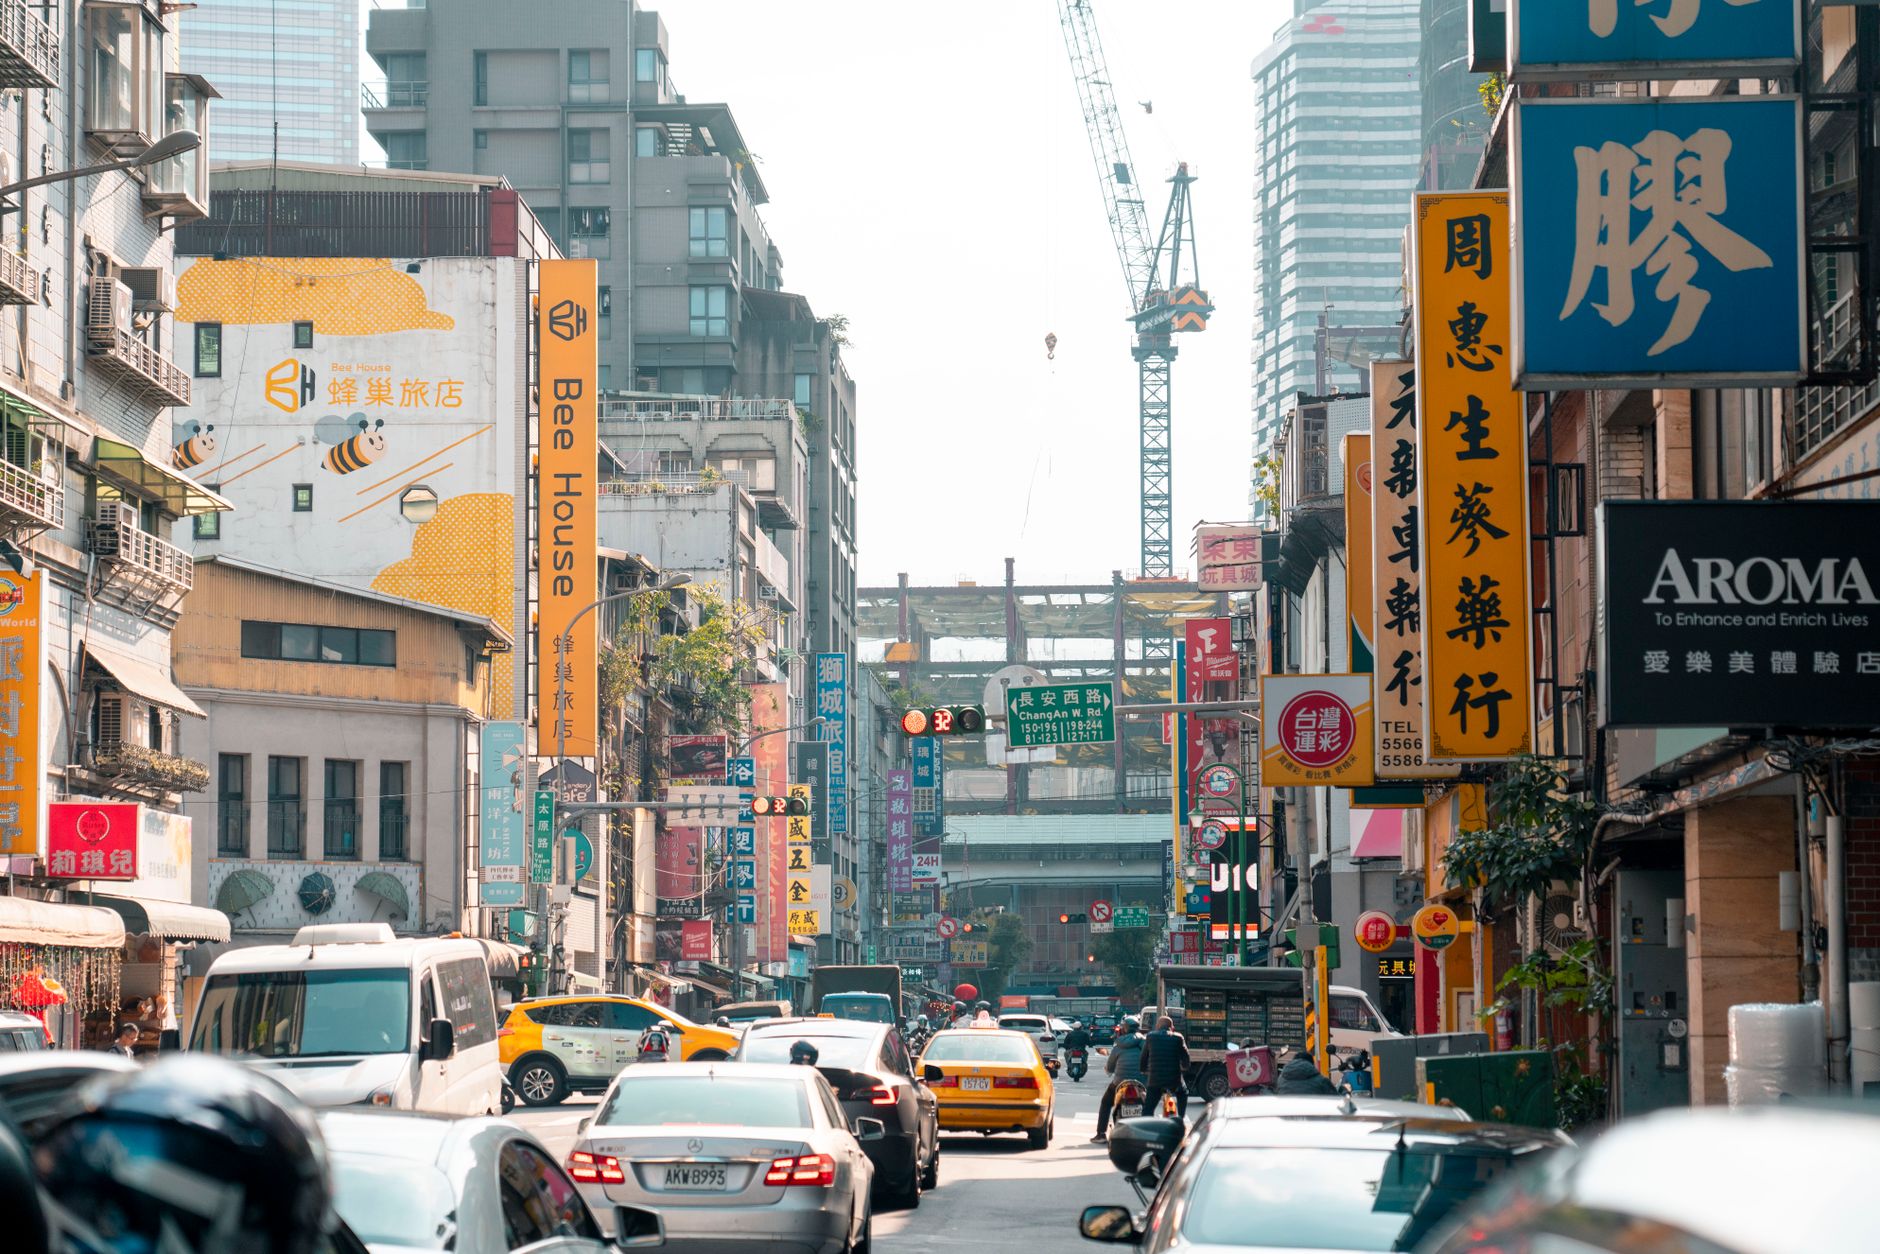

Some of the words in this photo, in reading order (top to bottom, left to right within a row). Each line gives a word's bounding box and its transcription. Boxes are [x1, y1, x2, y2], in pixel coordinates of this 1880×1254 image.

[1559, 127, 1774, 357] 膠
[331, 362, 352, 372] Bee
[356, 363, 392, 372] House
[327, 376, 466, 409] 蜂巢旅店
[552, 378, 584, 451] Bee
[1444, 213, 1512, 740] 周惠生蔘藥行
[552, 472, 584, 597] House
[1201, 533, 1258, 561] 東東
[1201, 564, 1258, 585] 玩具城
[1642, 547, 1880, 605] AROMA
[1655, 612, 1673, 626] To
[1676, 612, 1743, 626] Enhance
[1746, 613, 1776, 626] and
[1780, 612, 1827, 626] Enrich
[1832, 612, 1869, 627] Lives
[1643, 650, 1880, 674] 愛樂美體驗店
[552, 634, 576, 739] 蜂巢旅店
[1018, 688, 1102, 708] 長安西路
[934, 712, 951, 731] 32
[1019, 710, 1068, 721] ChangAn
[1072, 708, 1084, 718] W.
[1087, 707, 1104, 717] Rd.
[1021, 722, 1057, 733] 150-196
[1066, 719, 1103, 731] 198-244
[1294, 706, 1342, 730] 台灣
[1025, 732, 1058, 743] 81-123
[1067, 731, 1103, 742] 127-171
[1382, 721, 1418, 734] TEL
[1293, 729, 1342, 754] 運彩
[774, 799, 786, 814] 32
[538, 803, 550, 848] 太原路
[51, 849, 134, 874] 莉琪兒
[917, 855, 939, 867] 24H
